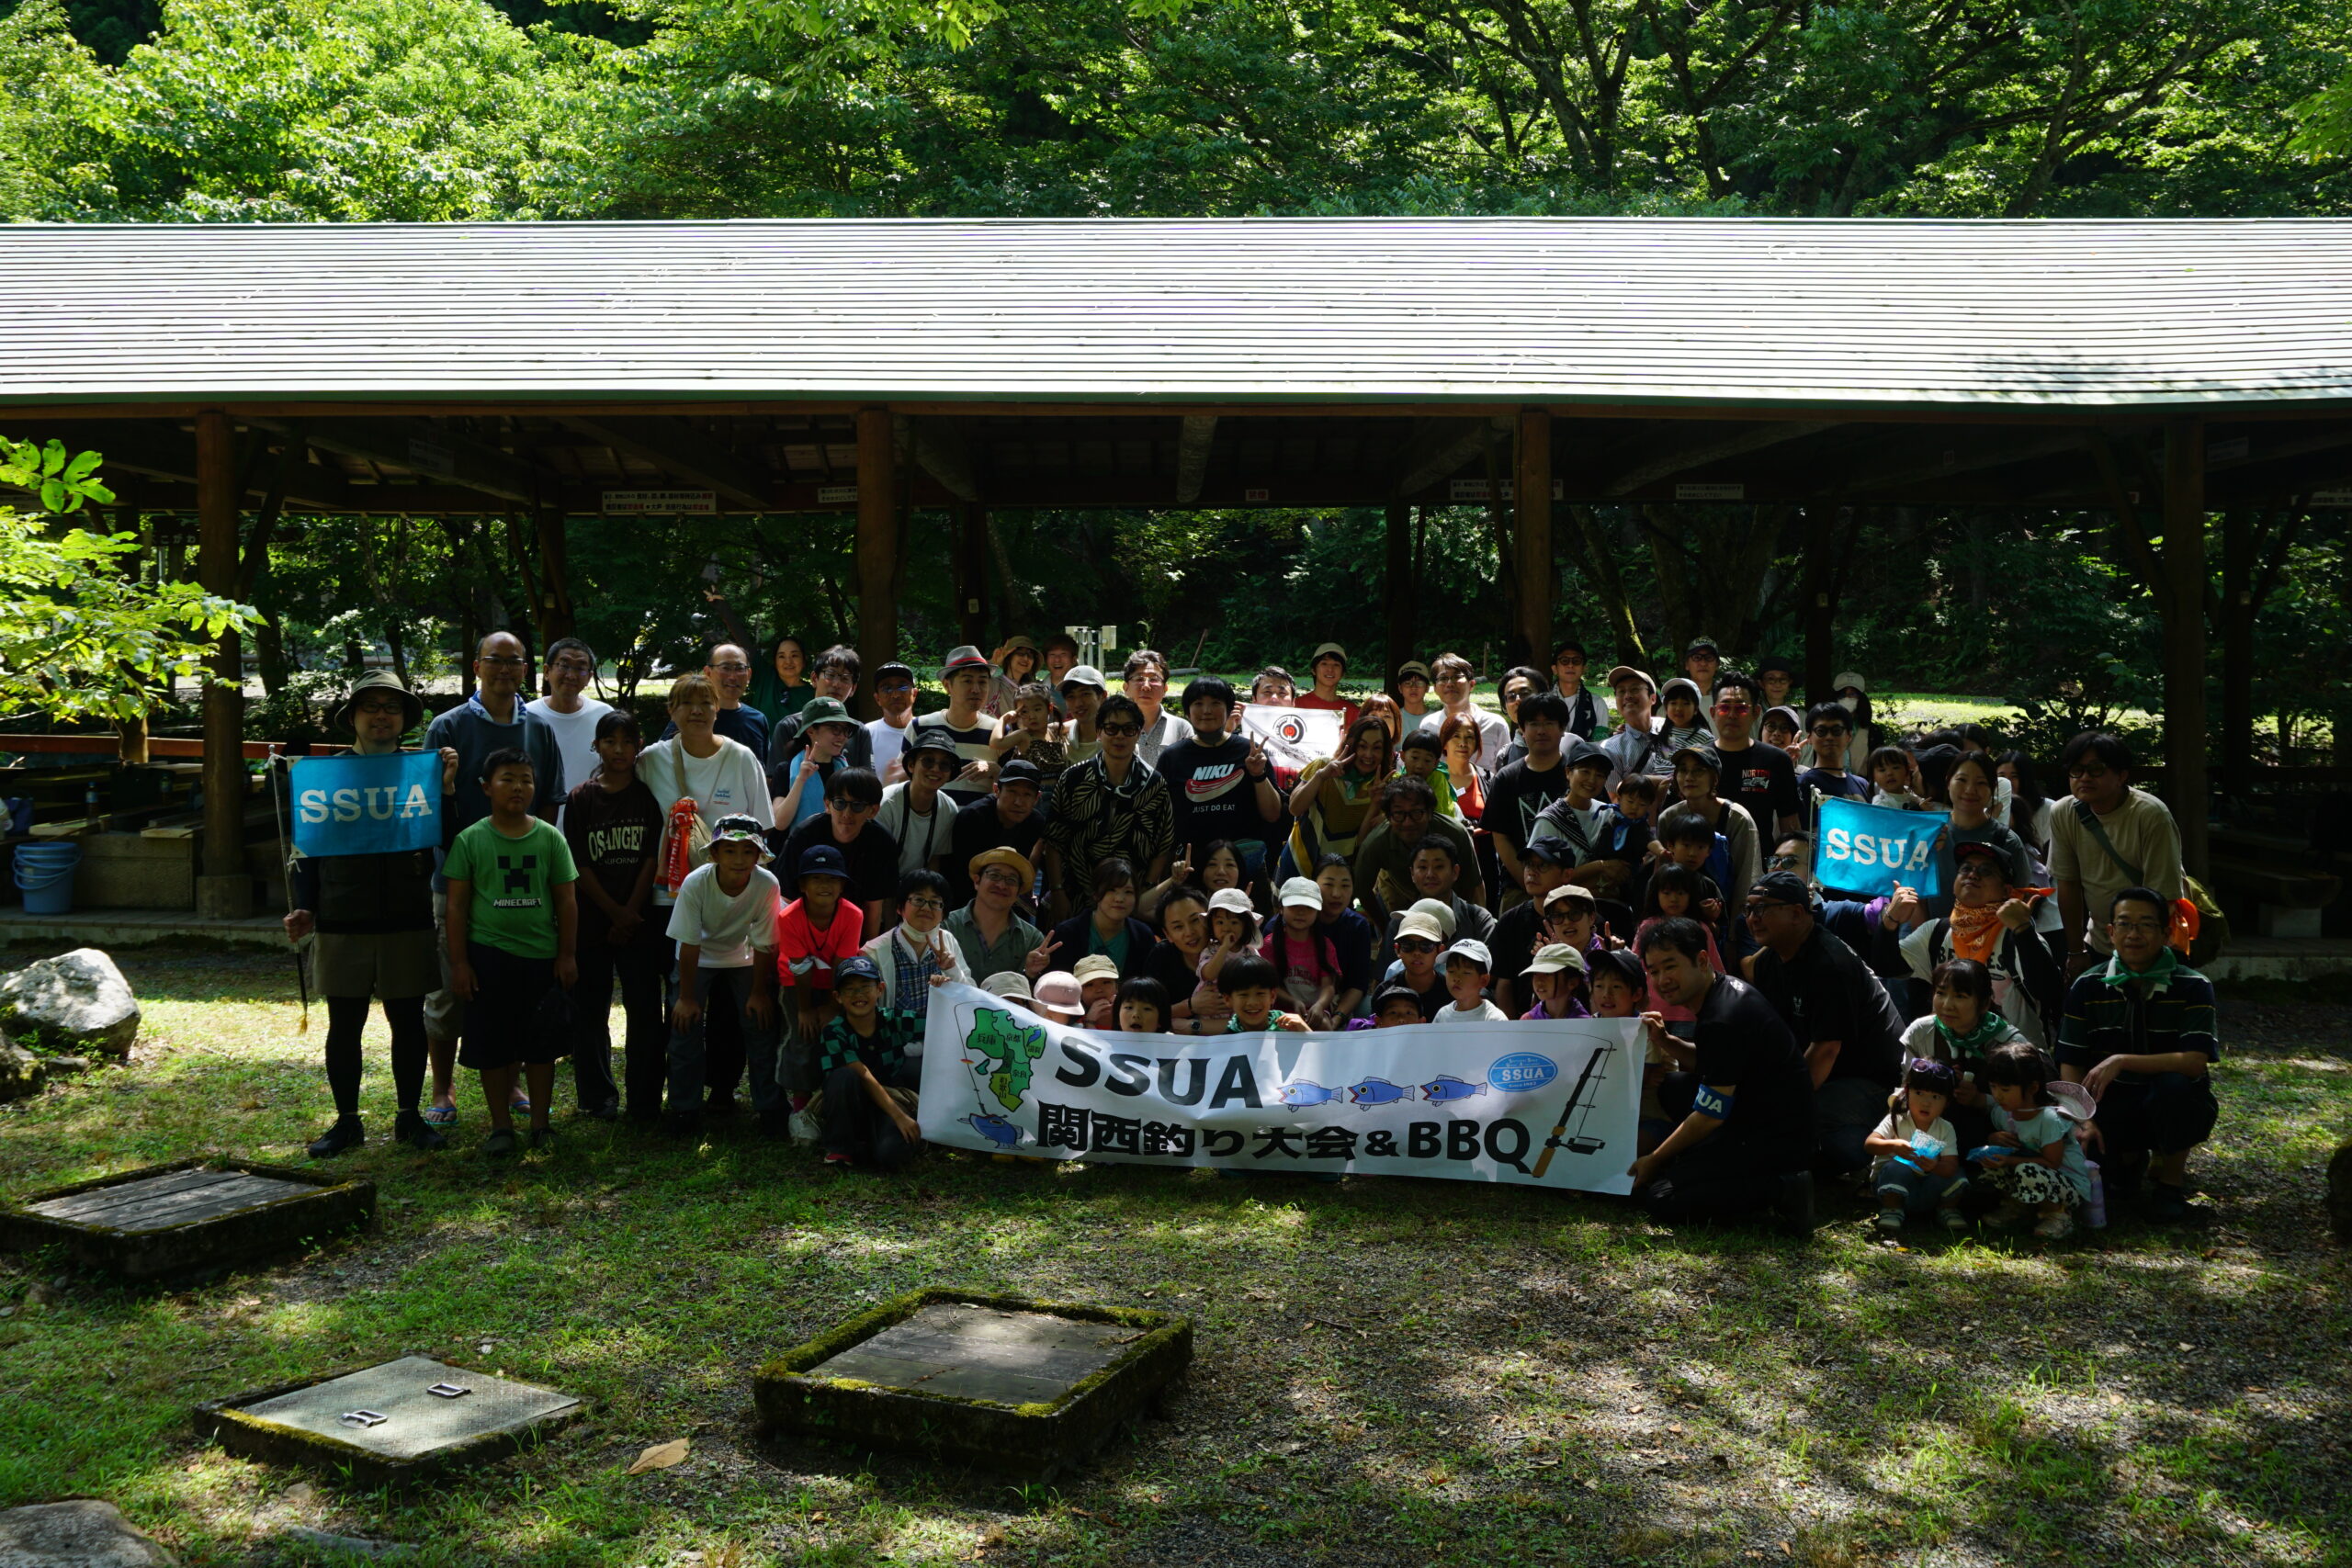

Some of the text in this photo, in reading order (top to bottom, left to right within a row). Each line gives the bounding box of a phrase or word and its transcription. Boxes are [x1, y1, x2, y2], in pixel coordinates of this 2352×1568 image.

[1193, 763, 1236, 781] NIKU
[300, 784, 434, 824] SSUA
[1193, 806, 1210, 814] JUST
[1826, 828, 1929, 872] SSUA
[493, 897, 543, 908] MINECRAFT
[978, 1033, 997, 1045] 兵庫
[1055, 1035, 1263, 1110] SSUA
[1501, 1067, 1544, 1081] SSUA
[1696, 1088, 1723, 1113] UA
